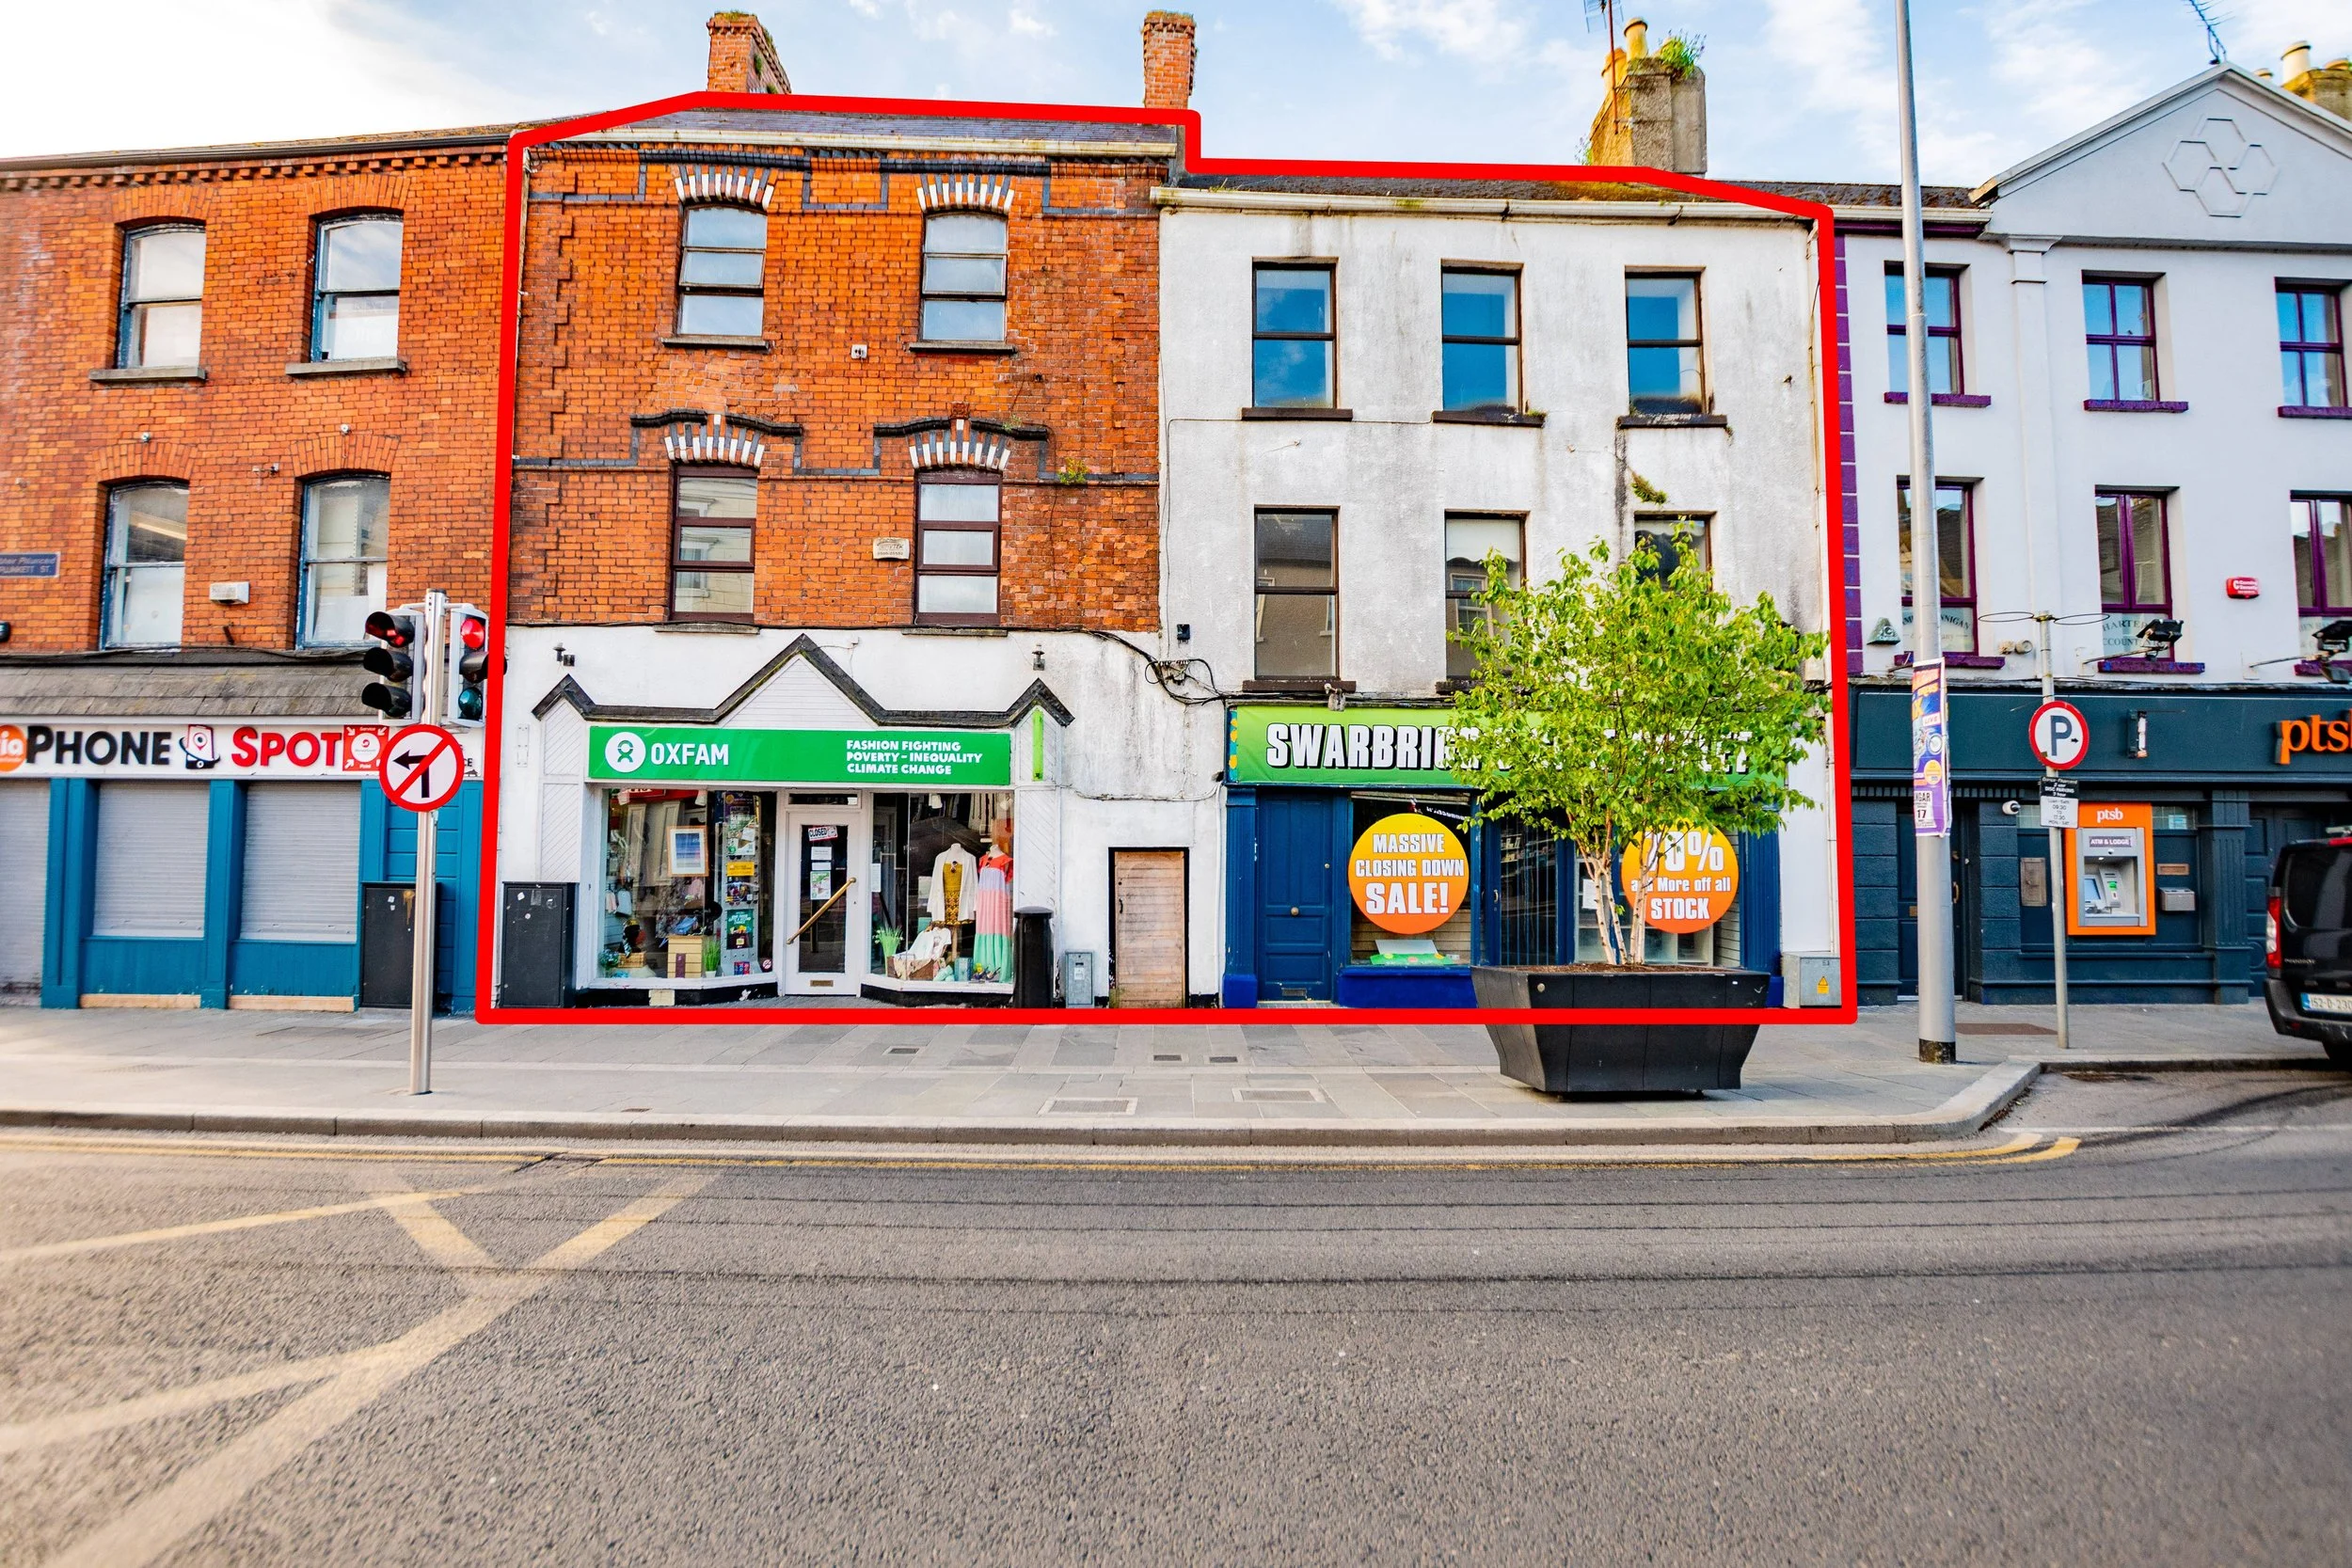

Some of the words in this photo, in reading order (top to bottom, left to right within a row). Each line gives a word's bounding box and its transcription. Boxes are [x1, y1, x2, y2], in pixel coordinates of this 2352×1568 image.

[0, 730, 24, 756] ia
[847, 739, 899, 751] FASHION
[901, 741, 961, 752] FIGHTING
[2050, 715, 2073, 757] P
[2280, 708, 2352, 766] pts
[26, 725, 172, 766] PHONE
[230, 726, 343, 768] SPOT
[650, 742, 730, 766] OXFAM
[847, 752, 899, 762] POVERTY
[909, 752, 983, 763] INEQUALITY
[847, 763, 899, 774] CLIMATE
[900, 764, 952, 775] CHANGE
[1917, 809, 1927, 819] 17
[2096, 807, 2123, 823] ptsb
[809, 828, 828, 837] CLOSED
[1373, 833, 1445, 853] MASSIVE
[1644, 831, 1724, 872] 70%
[1355, 859, 1417, 877] CLOSING
[1422, 860, 1465, 877] DOWN
[1630, 879, 1654, 892] ad
[1658, 877, 1690, 892] More
[1694, 877, 1712, 892] off
[1715, 877, 1731, 892] all
[1365, 882, 1450, 914] SALE!
[1650, 897, 1710, 920] STOCK
